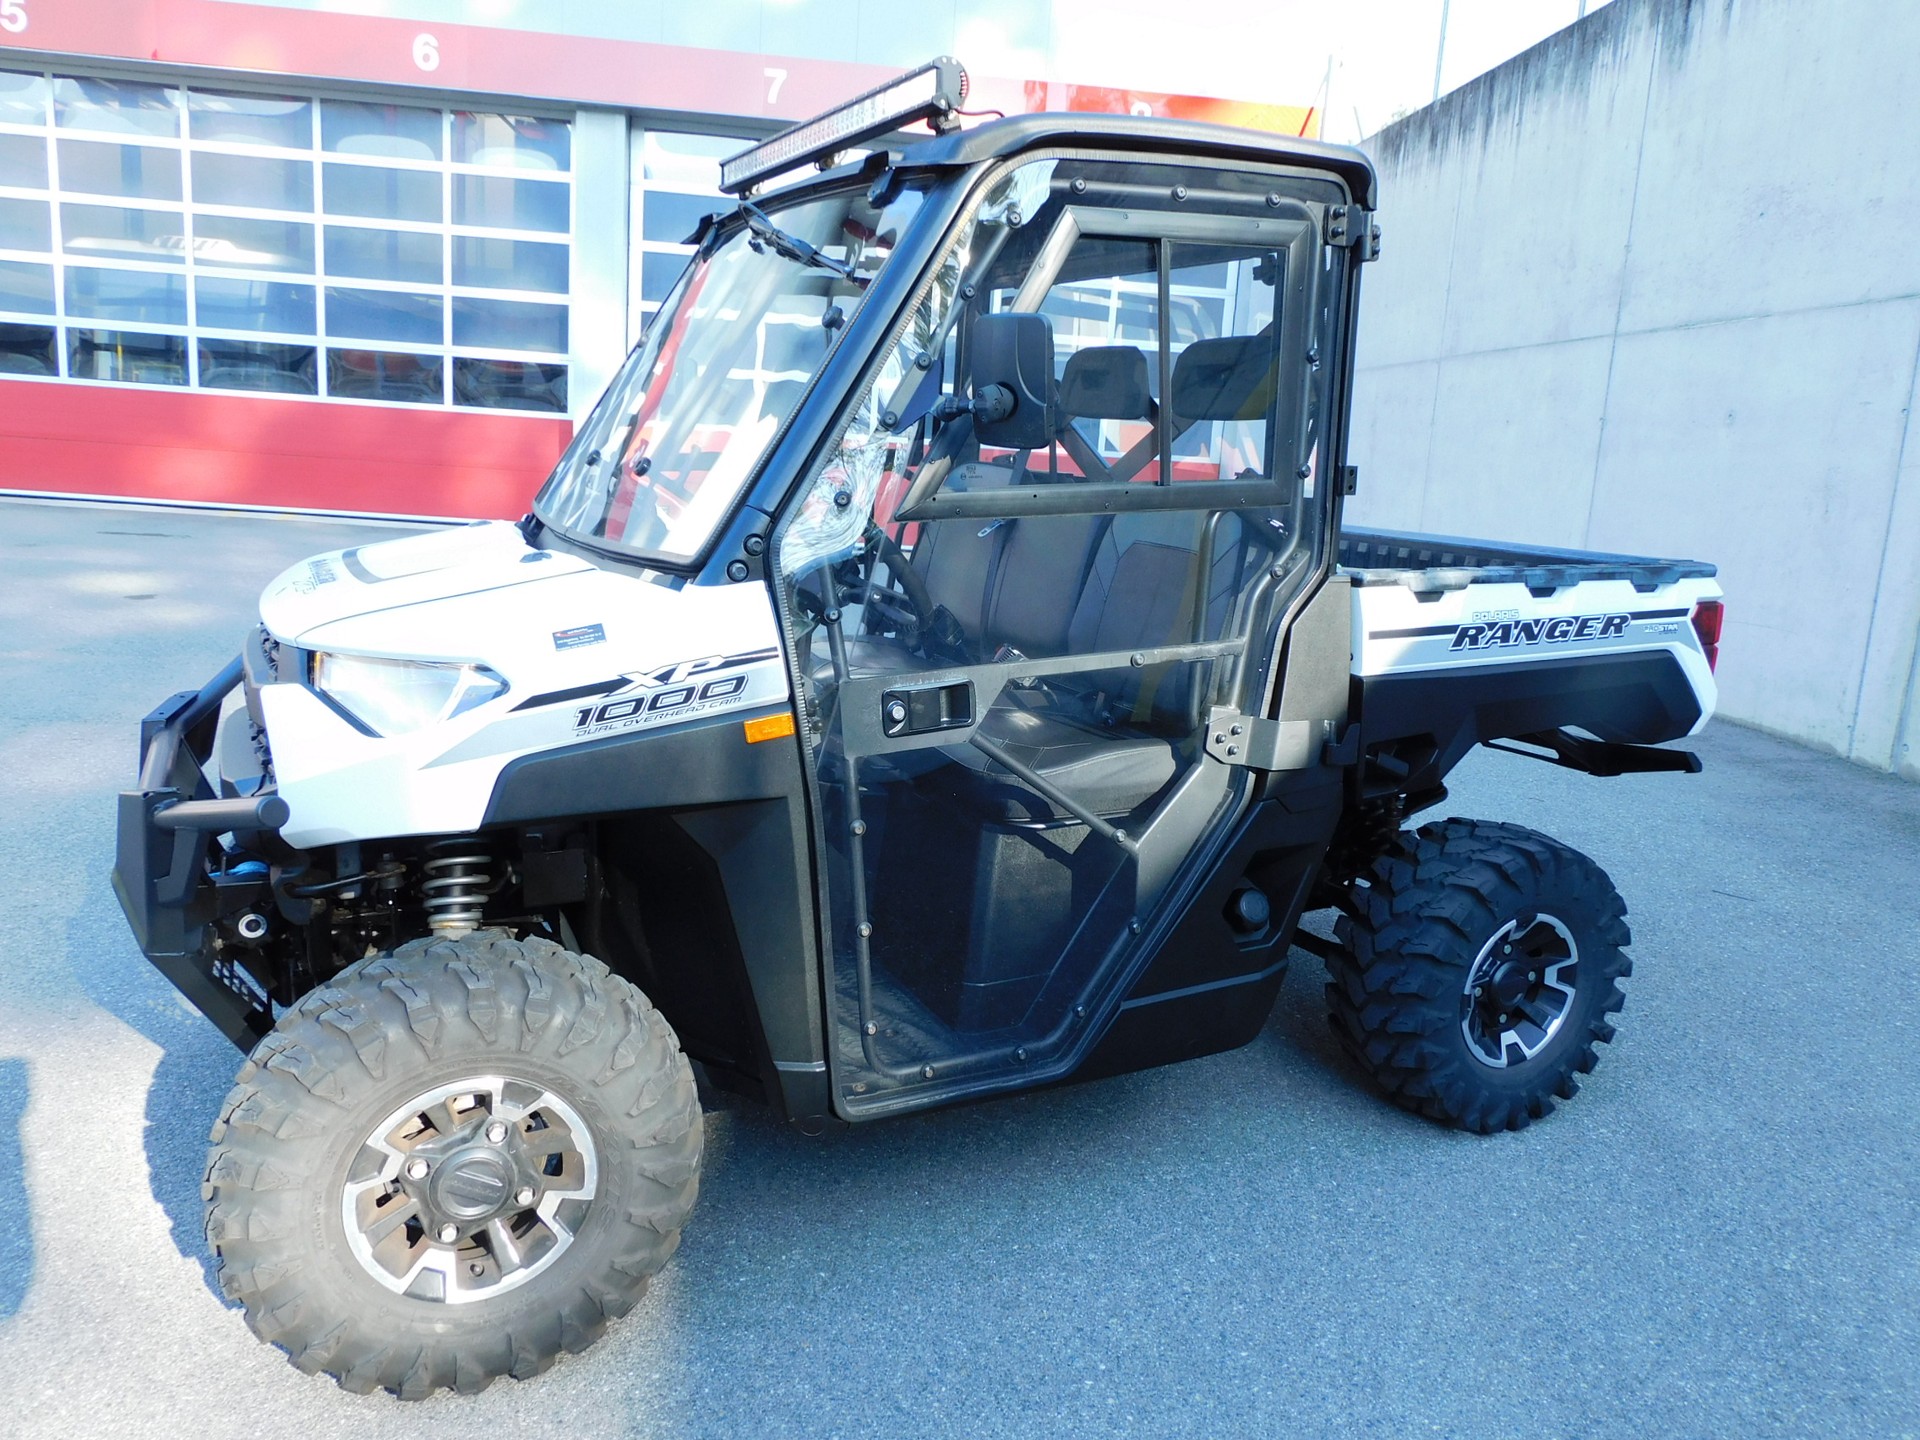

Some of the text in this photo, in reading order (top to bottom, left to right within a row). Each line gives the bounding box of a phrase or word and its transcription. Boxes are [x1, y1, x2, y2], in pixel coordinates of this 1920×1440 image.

[0, 0, 27, 32] 5
[412, 32, 440, 72] 6
[763, 67, 788, 104] 7
[1449, 613, 1631, 650] RANGER
[1472, 609, 1520, 622] POLARIS
[605, 655, 726, 697] XP
[573, 672, 748, 731] 1000
[576, 696, 742, 737] DUAL OVERHEAD CAM
